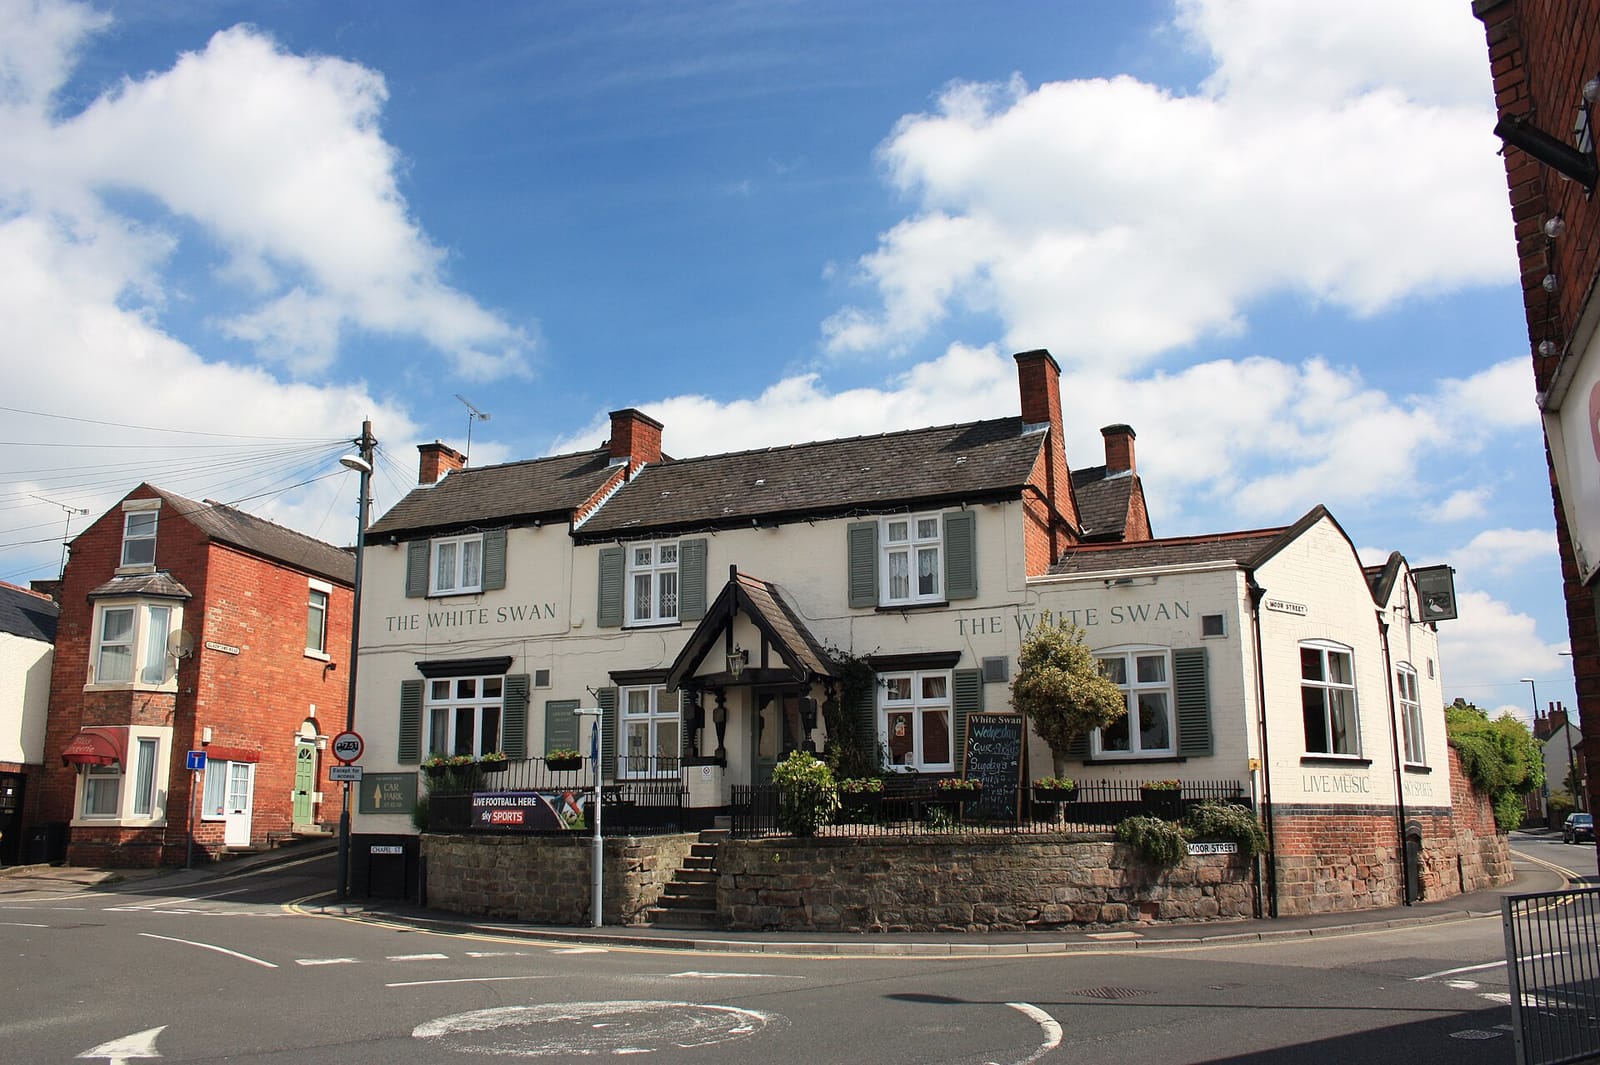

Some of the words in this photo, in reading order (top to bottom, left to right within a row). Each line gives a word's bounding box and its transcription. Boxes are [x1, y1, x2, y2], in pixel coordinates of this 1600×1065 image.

[385, 614, 420, 632] THE
[427, 608, 489, 629] WHITE
[496, 602, 557, 623] SWAN
[954, 616, 1003, 636] THE
[1110, 600, 1191, 624] SWAN
[971, 715, 997, 724] White
[998, 715, 1022, 724] Swan
[383, 783, 399, 791] CAR
[1302, 774, 1331, 793] LIVE
[1332, 775, 1370, 794] MUSIC
[383, 792, 404, 801] PARK
[473, 797, 486, 807] LIVE
[486, 797, 517, 807] FOOTBALL
[518, 797, 537, 806] HERE
[481, 810, 492, 823] sky
[493, 811, 523, 822] SPORTS
[1188, 844, 1210, 853] MOOR
[1211, 843, 1236, 853] STREET
